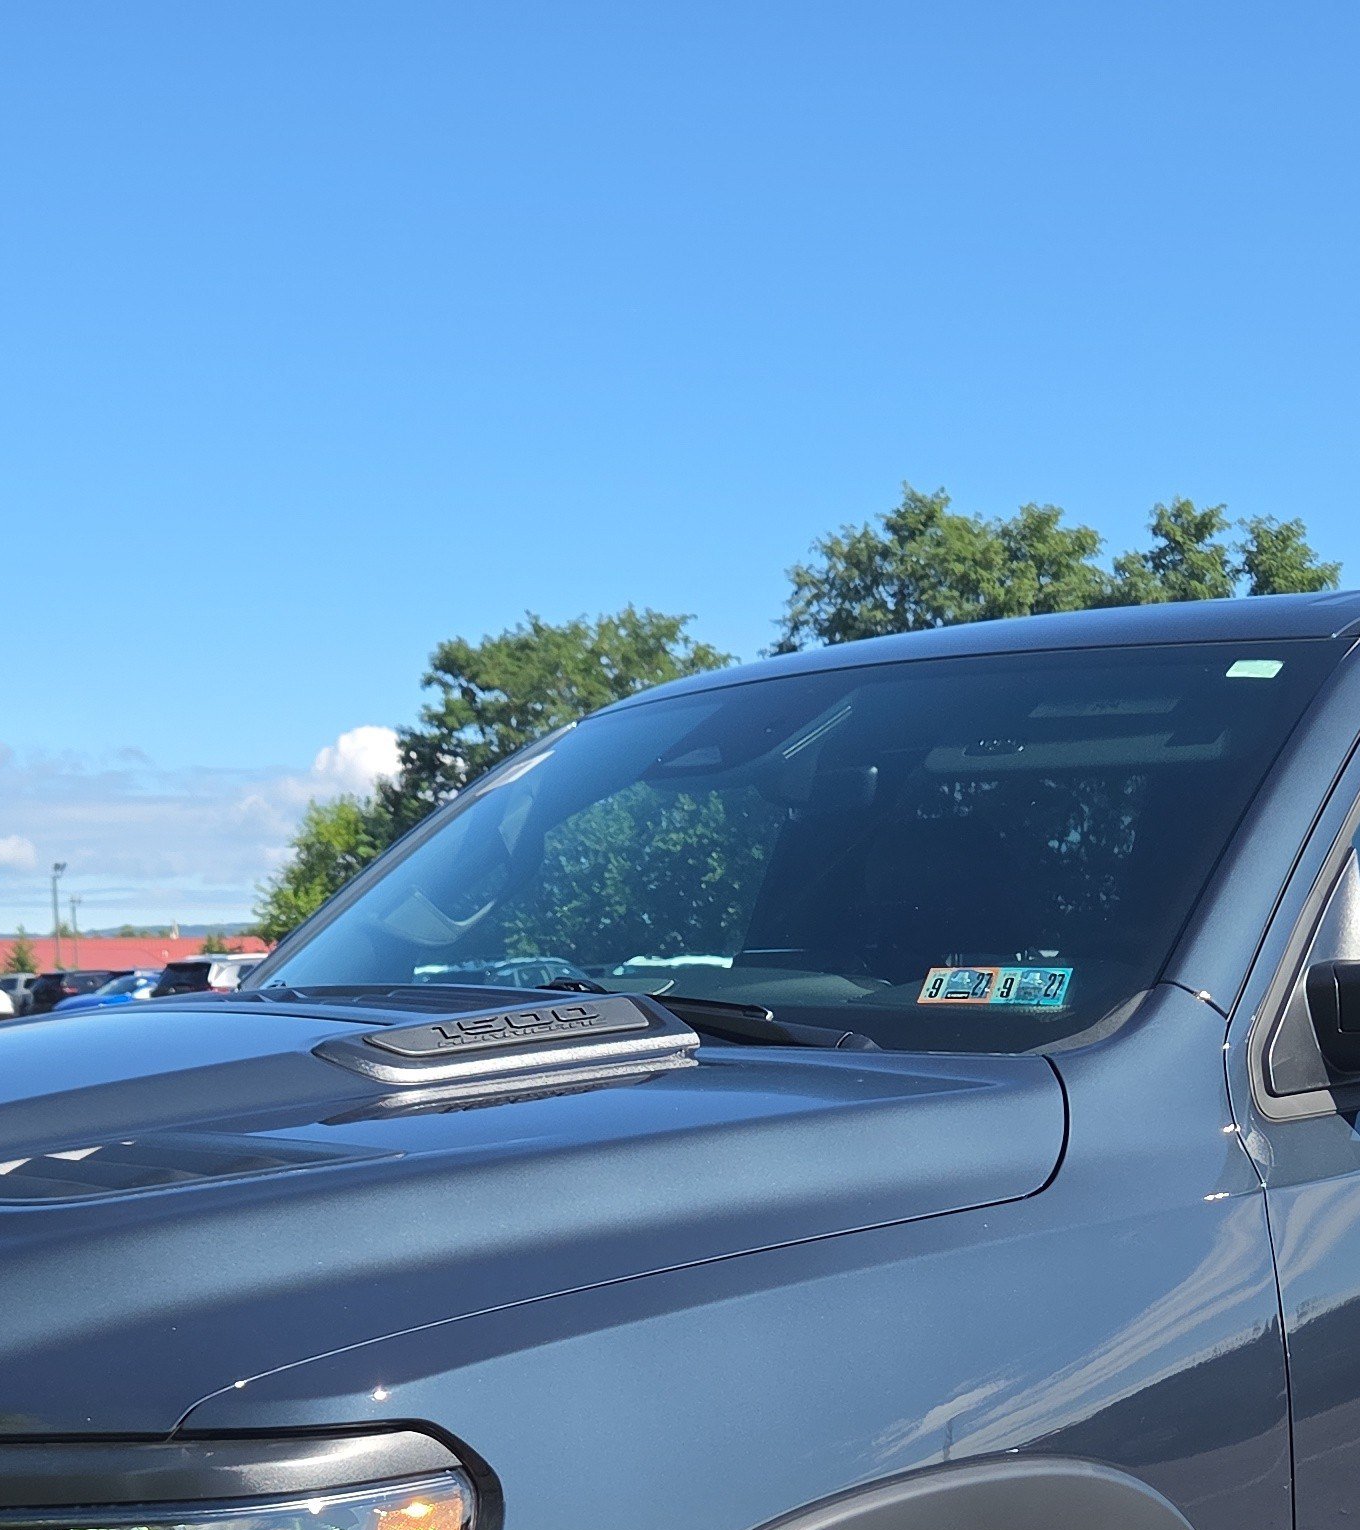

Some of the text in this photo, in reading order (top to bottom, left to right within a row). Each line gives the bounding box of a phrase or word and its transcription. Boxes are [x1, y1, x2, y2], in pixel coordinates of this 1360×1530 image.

[927, 973, 994, 998] 9 27
[999, 973, 1066, 998] 9 27
[431, 1006, 600, 1040] 1500
